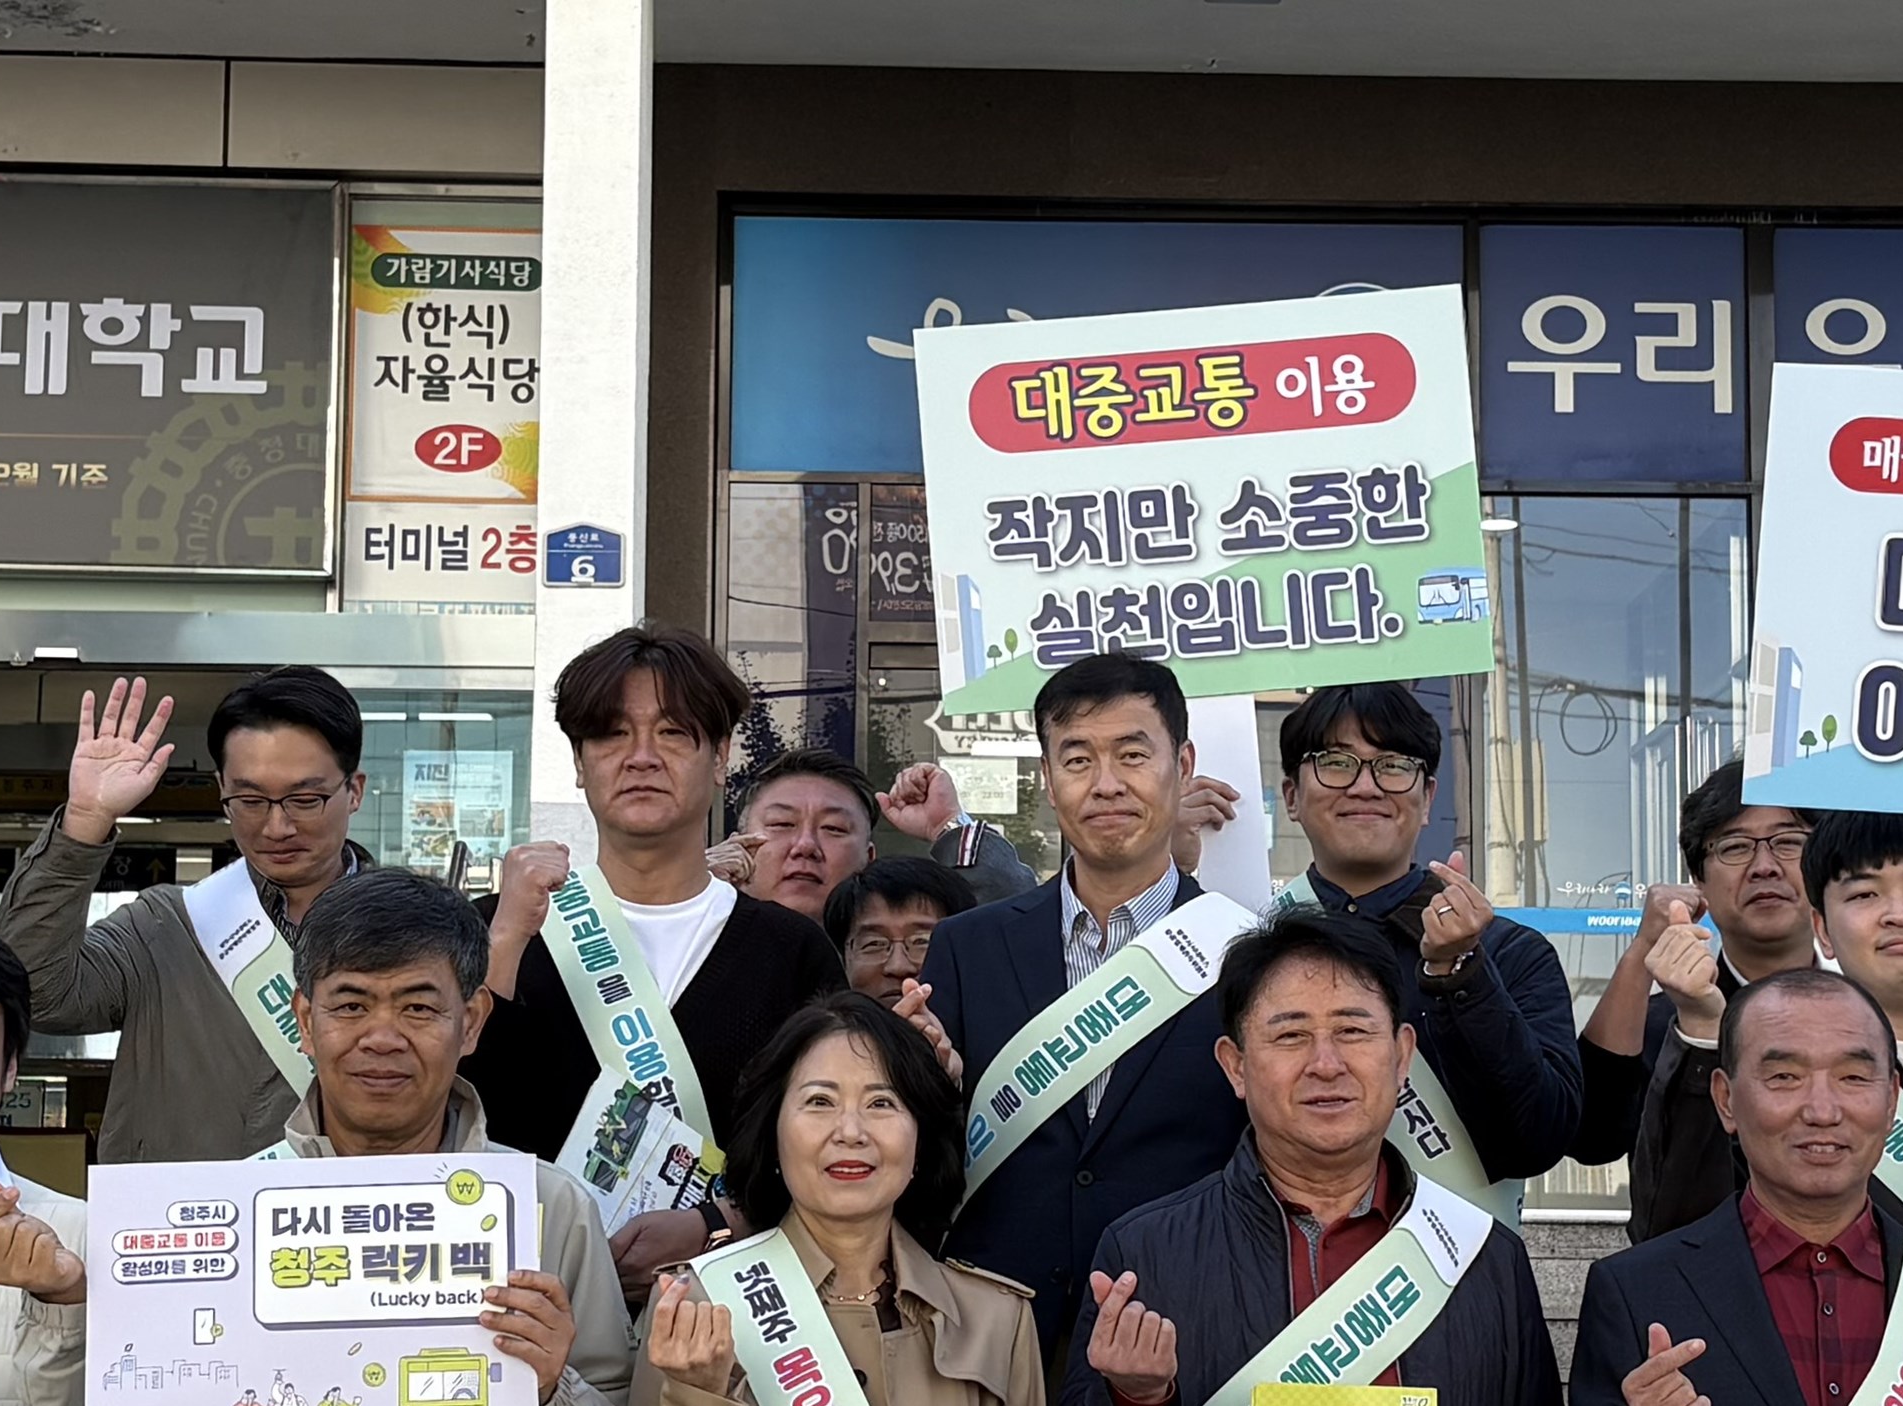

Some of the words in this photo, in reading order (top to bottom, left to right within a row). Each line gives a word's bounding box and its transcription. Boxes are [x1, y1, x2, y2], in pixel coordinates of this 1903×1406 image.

[386, 258, 532, 285] 가람기사식당
[401, 302, 510, 349] (한식)
[1507, 293, 1735, 415] 우리
[373, 355, 540, 402] 자율식당
[1010, 353, 1256, 442] 대중교통
[1274, 353, 1375, 418] 이용
[433, 432, 484, 465] 2F
[52, 463, 109, 486] 기준
[984, 479, 1197, 572] 작지만
[1217, 462, 1432, 557] 소중한
[364, 524, 471, 571] 터미널
[480, 526, 537, 574] 2층
[571, 556, 595, 577] 6
[1029, 563, 1405, 674] 실천입니다.
[179, 1204, 227, 1221] 청주시
[272, 1205, 331, 1236] 다시
[341, 1202, 436, 1233] 돌아온
[192, 1257, 226, 1274] 위한
[270, 1246, 351, 1287] 청주
[361, 1244, 441, 1283] 럭키
[450, 1242, 493, 1281] 백
[370, 1290, 431, 1308] (Lucky
[435, 1288, 485, 1307] back)
[732, 1258, 798, 1348] 넷째주
